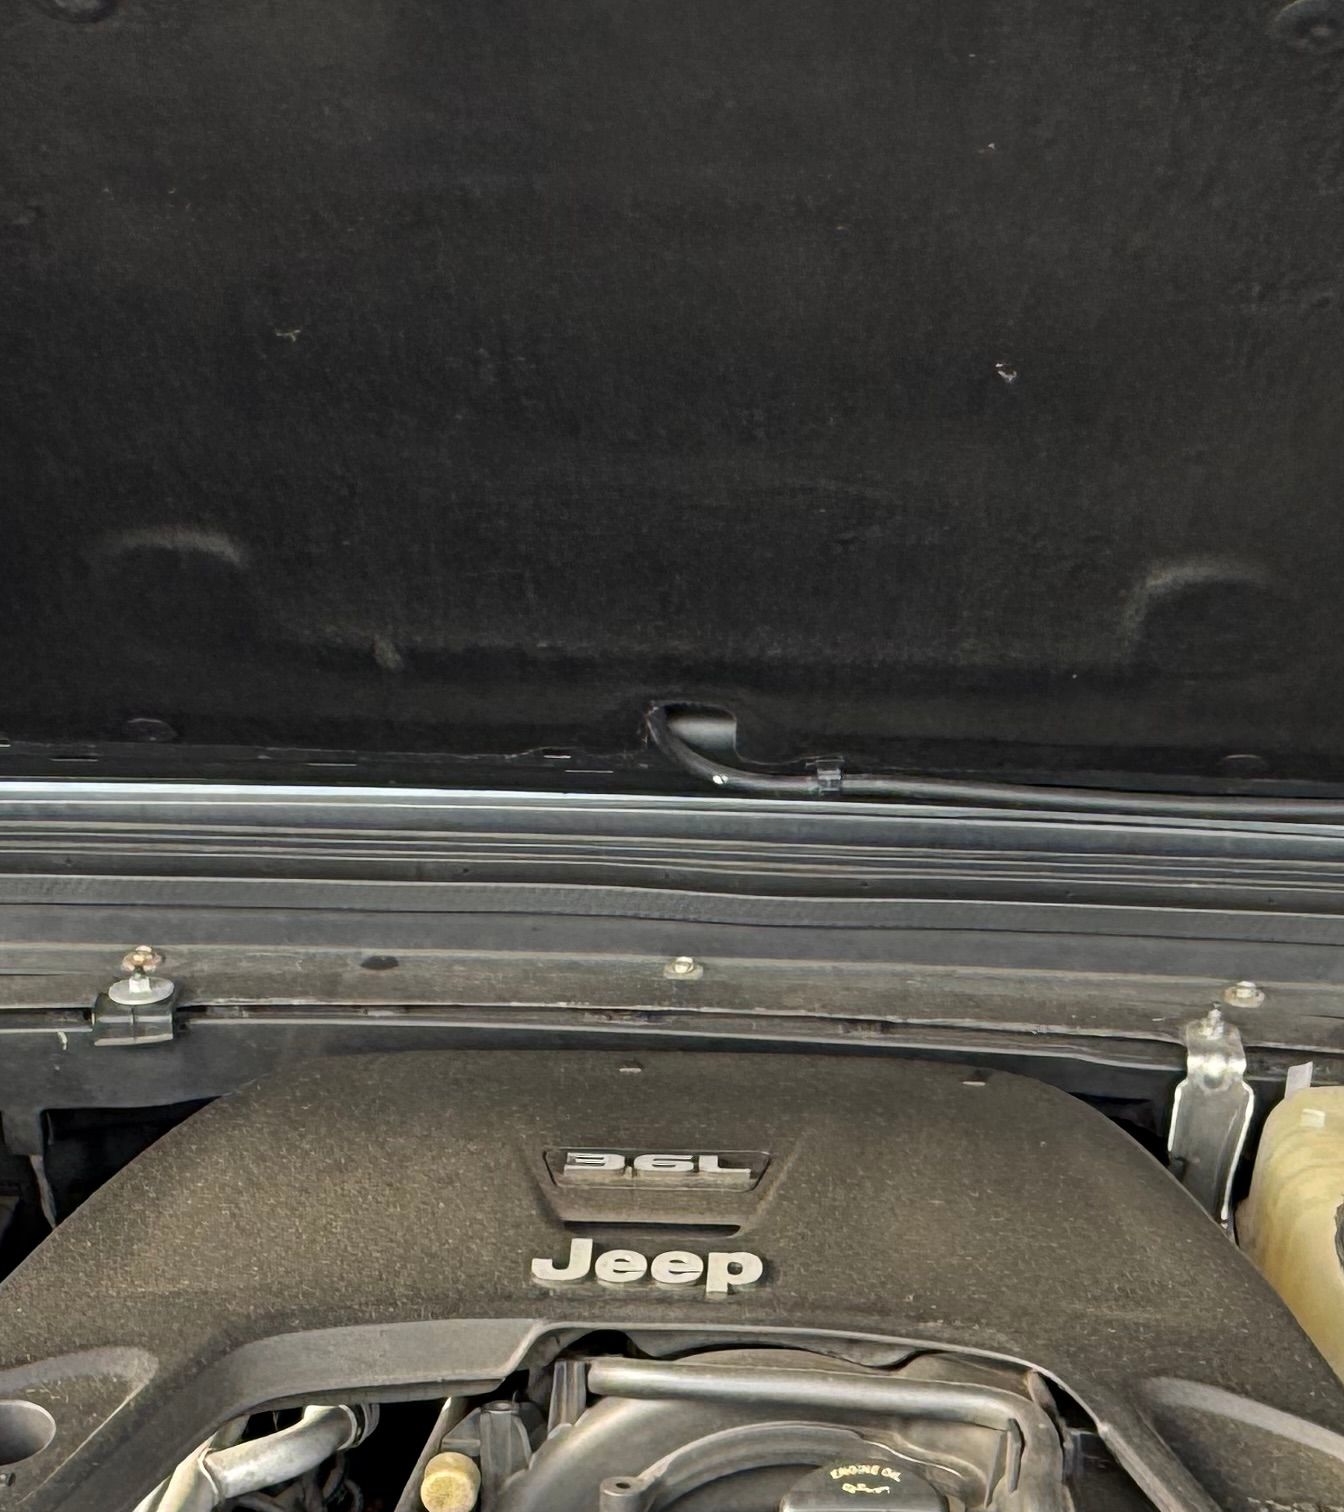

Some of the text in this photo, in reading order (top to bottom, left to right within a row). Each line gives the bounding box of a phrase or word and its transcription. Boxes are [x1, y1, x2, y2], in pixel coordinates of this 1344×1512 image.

[531, 1238, 764, 1294] Jeep
[829, 1464, 902, 1483] ENGINE OIL
